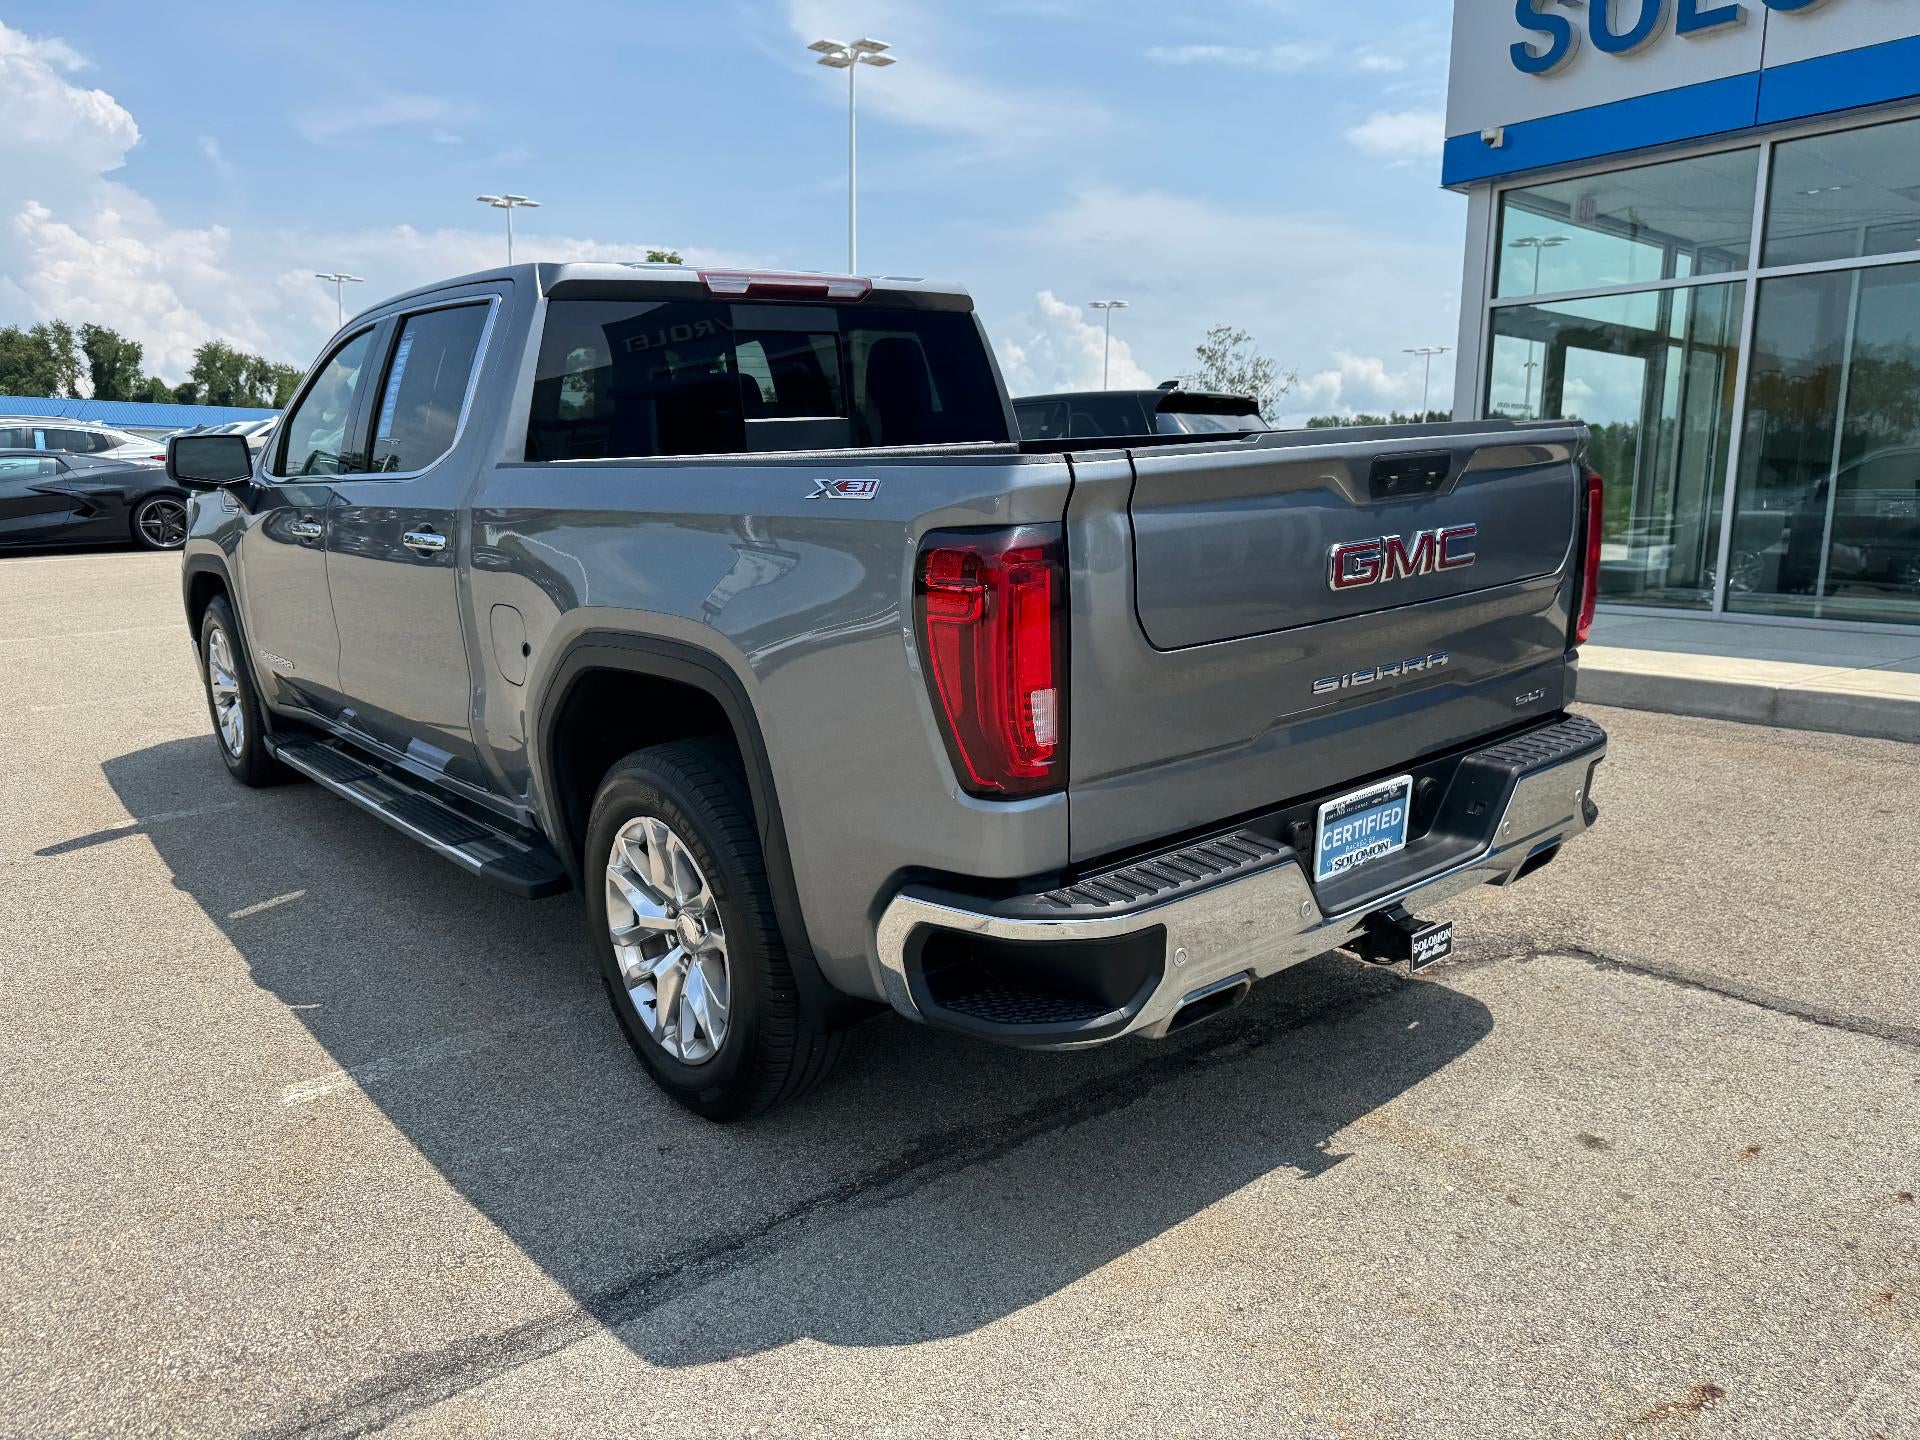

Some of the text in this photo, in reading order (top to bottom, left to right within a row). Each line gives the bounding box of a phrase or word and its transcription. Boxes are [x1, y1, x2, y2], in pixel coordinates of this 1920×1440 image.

[1510, 0, 1828, 75] SOL
[805, 478, 881, 500] X31
[1327, 522, 1477, 592] GMC
[1311, 651, 1449, 695] SIERRA
[1514, 687, 1547, 706] SLT
[1322, 806, 1402, 851] CERTIFIED
[1345, 835, 1376, 853] BACKED BY
[1334, 840, 1390, 872] SOLOMON
[1413, 927, 1452, 954] SOLOMON
